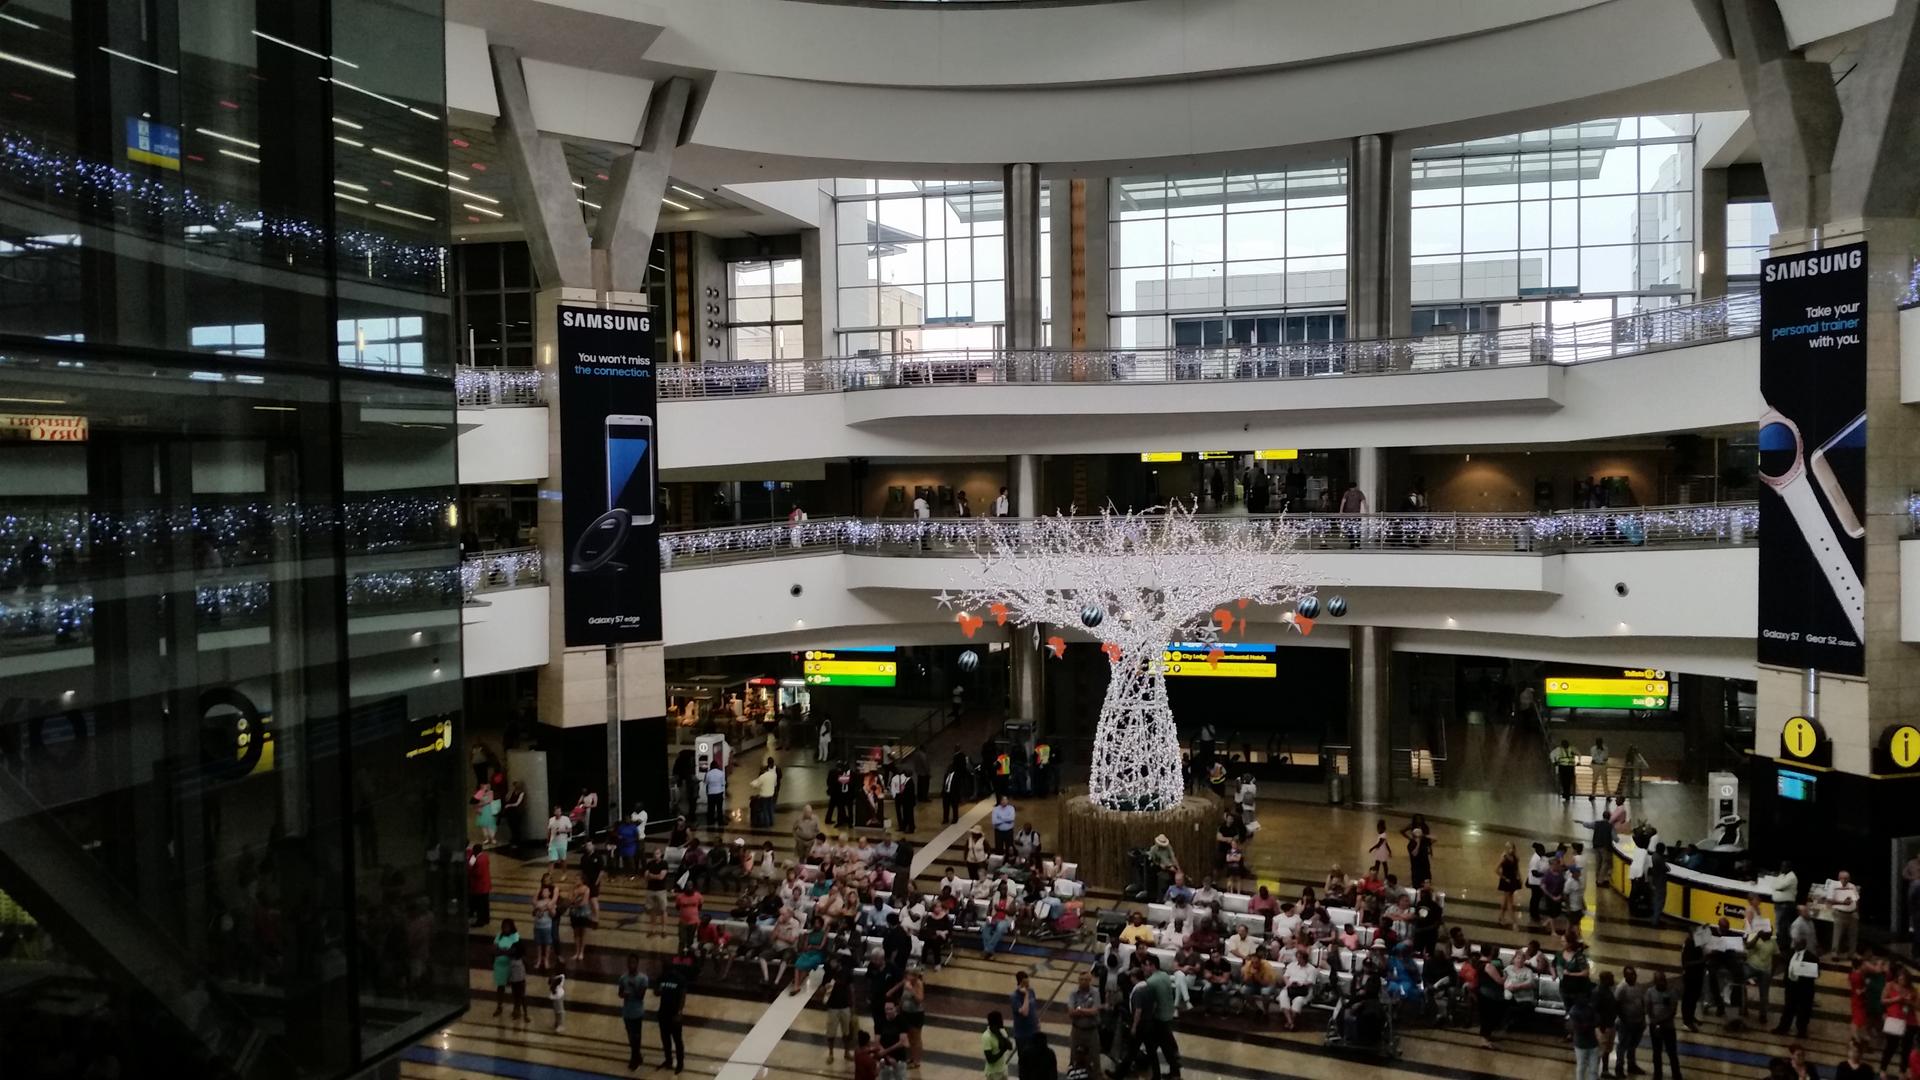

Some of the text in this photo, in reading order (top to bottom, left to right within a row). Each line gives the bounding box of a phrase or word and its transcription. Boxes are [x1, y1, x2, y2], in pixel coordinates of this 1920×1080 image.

[1765, 250, 1862, 282] SAMSUNG
[1805, 302, 1860, 318] Take your
[563, 311, 650, 331] SAMSUNG
[1772, 318, 1859, 340] personal trainer
[1809, 334, 1860, 349] with you.
[578, 352, 650, 365] You won't miss
[575, 365, 650, 377] the connection.
[588, 616, 615, 624] Galaxy
[615, 615, 624, 623] S7
[1763, 629, 1800, 641] Galaxy S7
[1806, 633, 1827, 644] Gear
[1827, 636, 1837, 645] S2
[1182, 653, 1193, 661] City
